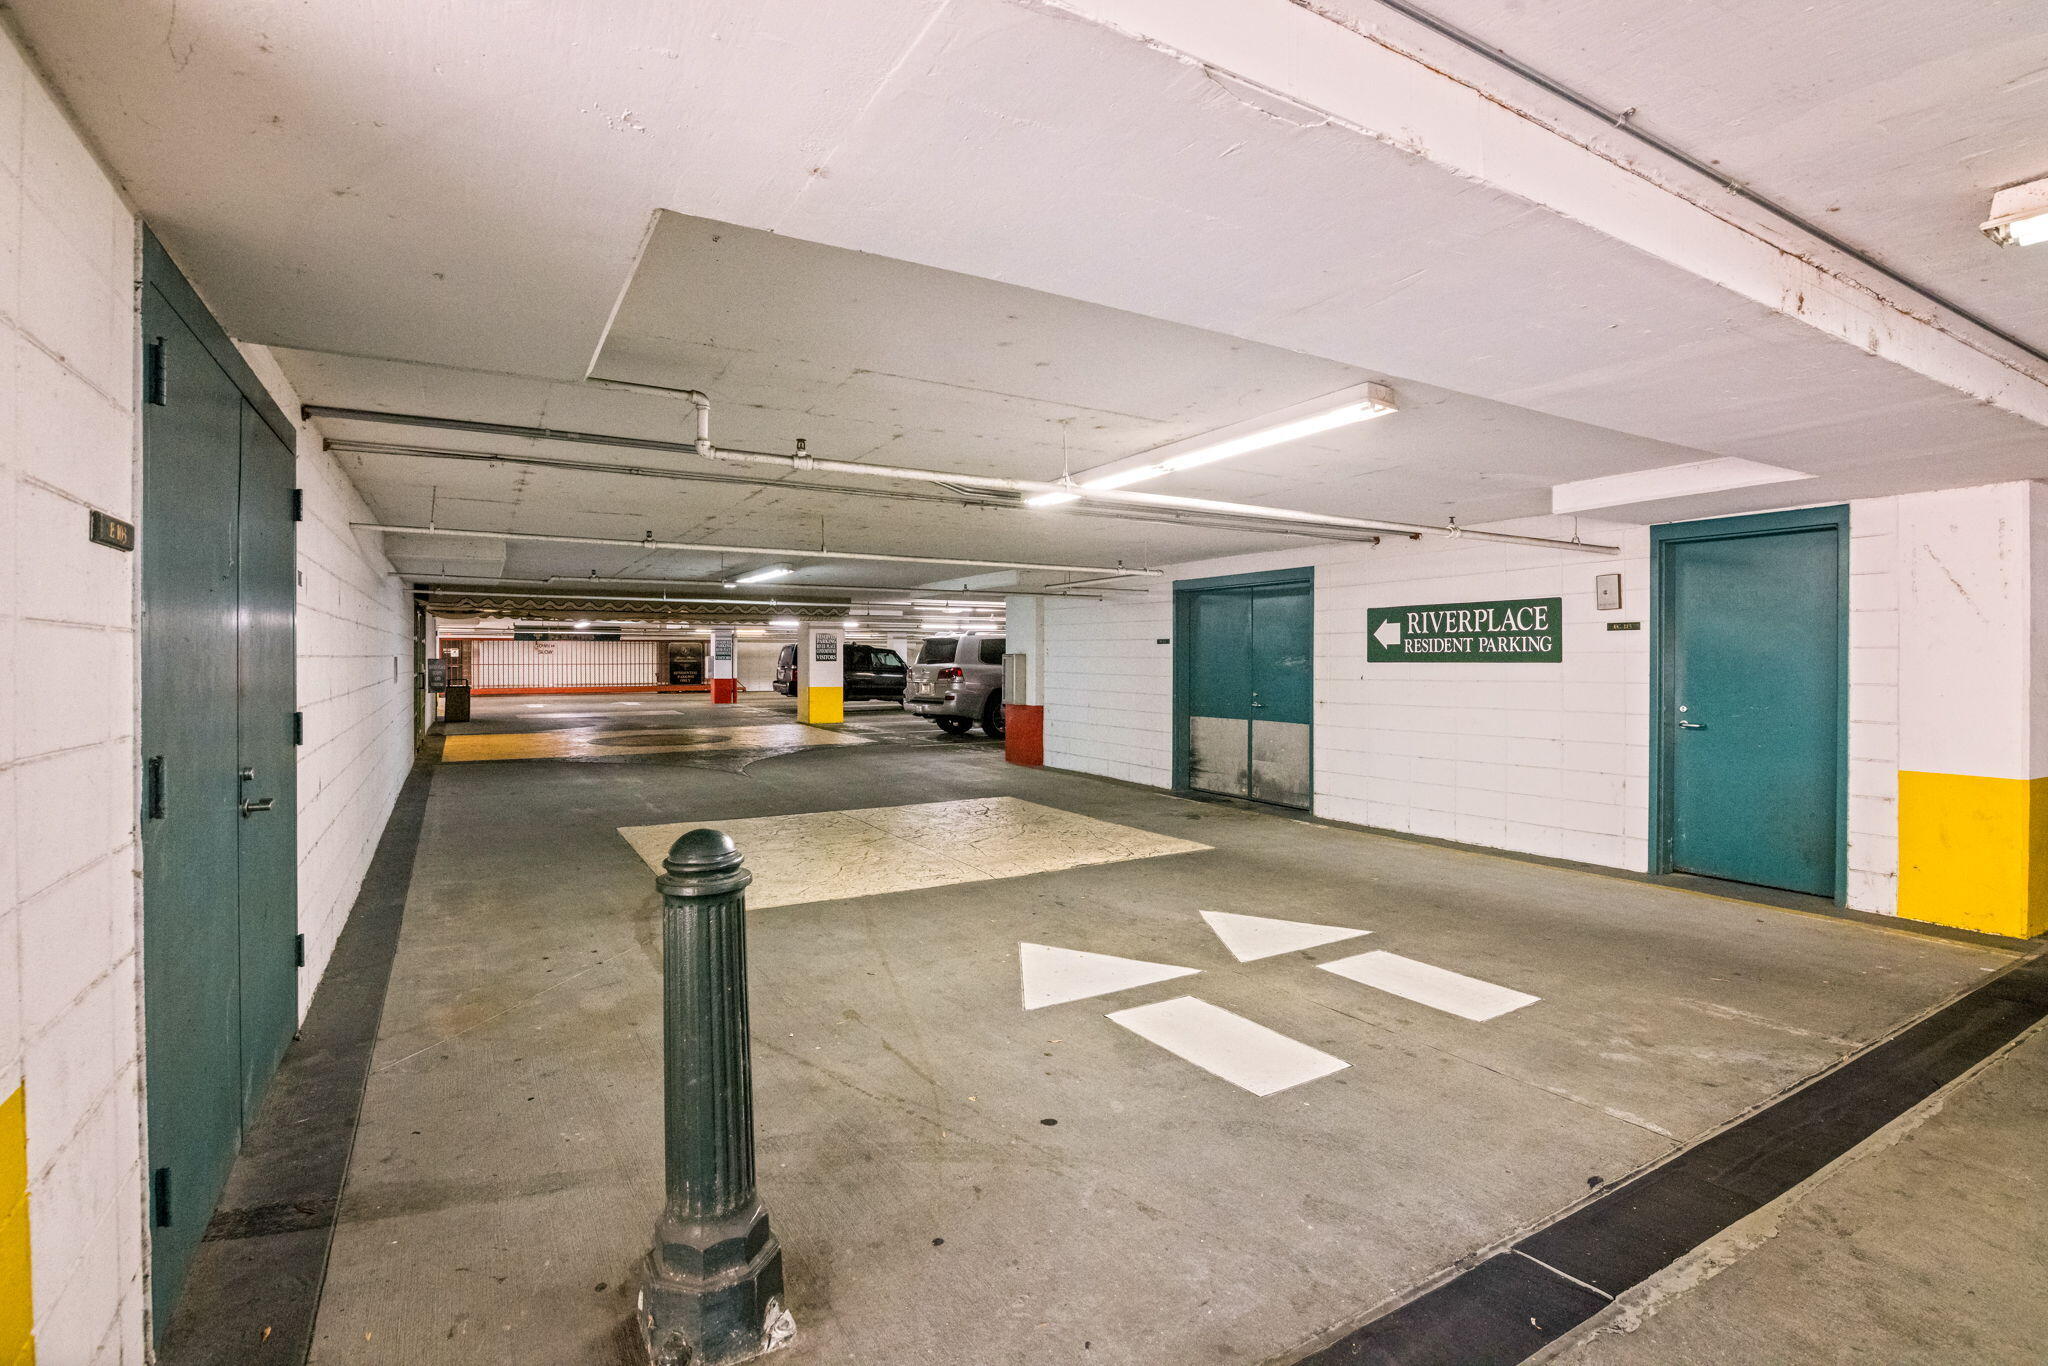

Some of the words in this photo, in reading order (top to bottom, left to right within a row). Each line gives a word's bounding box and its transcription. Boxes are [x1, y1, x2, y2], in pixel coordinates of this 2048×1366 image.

[109, 521, 115, 539] E
[1407, 606, 1549, 634] RIVERPLACE
[1404, 637, 1474, 653] RESIDENT
[1478, 636, 1553, 653] PARKING
